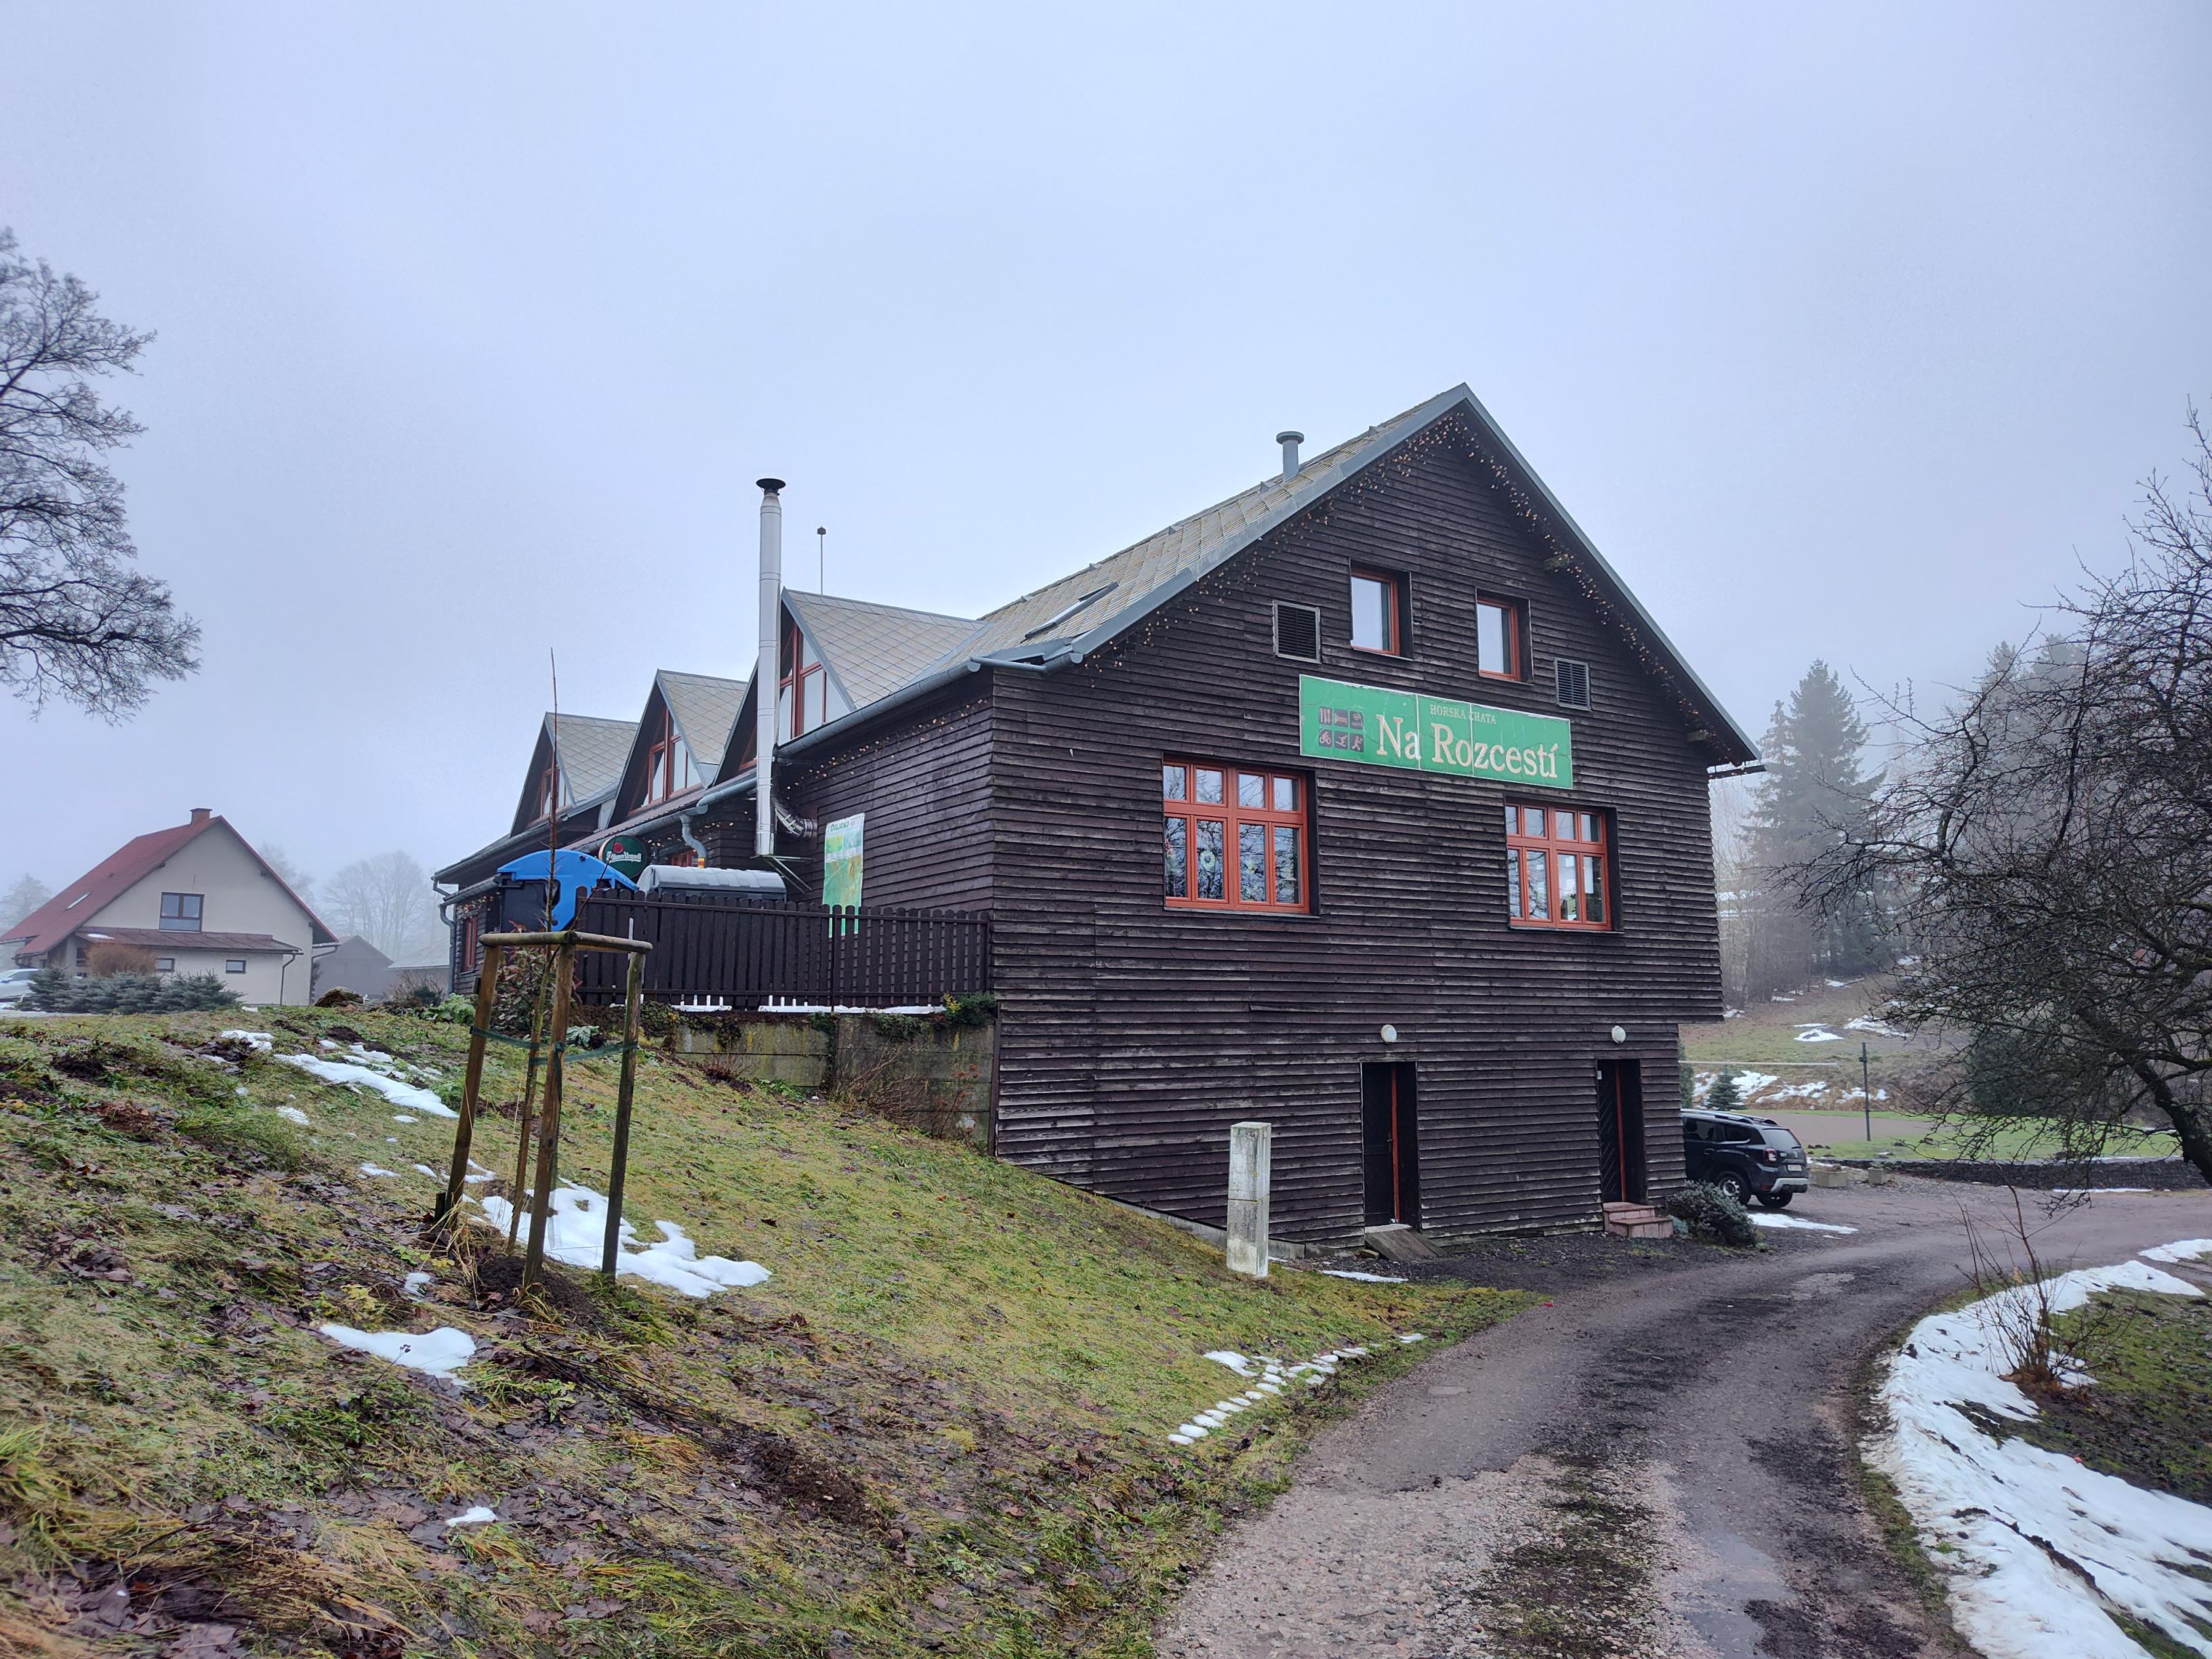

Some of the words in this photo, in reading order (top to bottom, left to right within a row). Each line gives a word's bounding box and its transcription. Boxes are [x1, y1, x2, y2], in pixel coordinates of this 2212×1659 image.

[1469, 712, 1496, 724] CHATA
[1376, 714, 1421, 760] Na
[1431, 723, 1558, 778] Rozcestí
